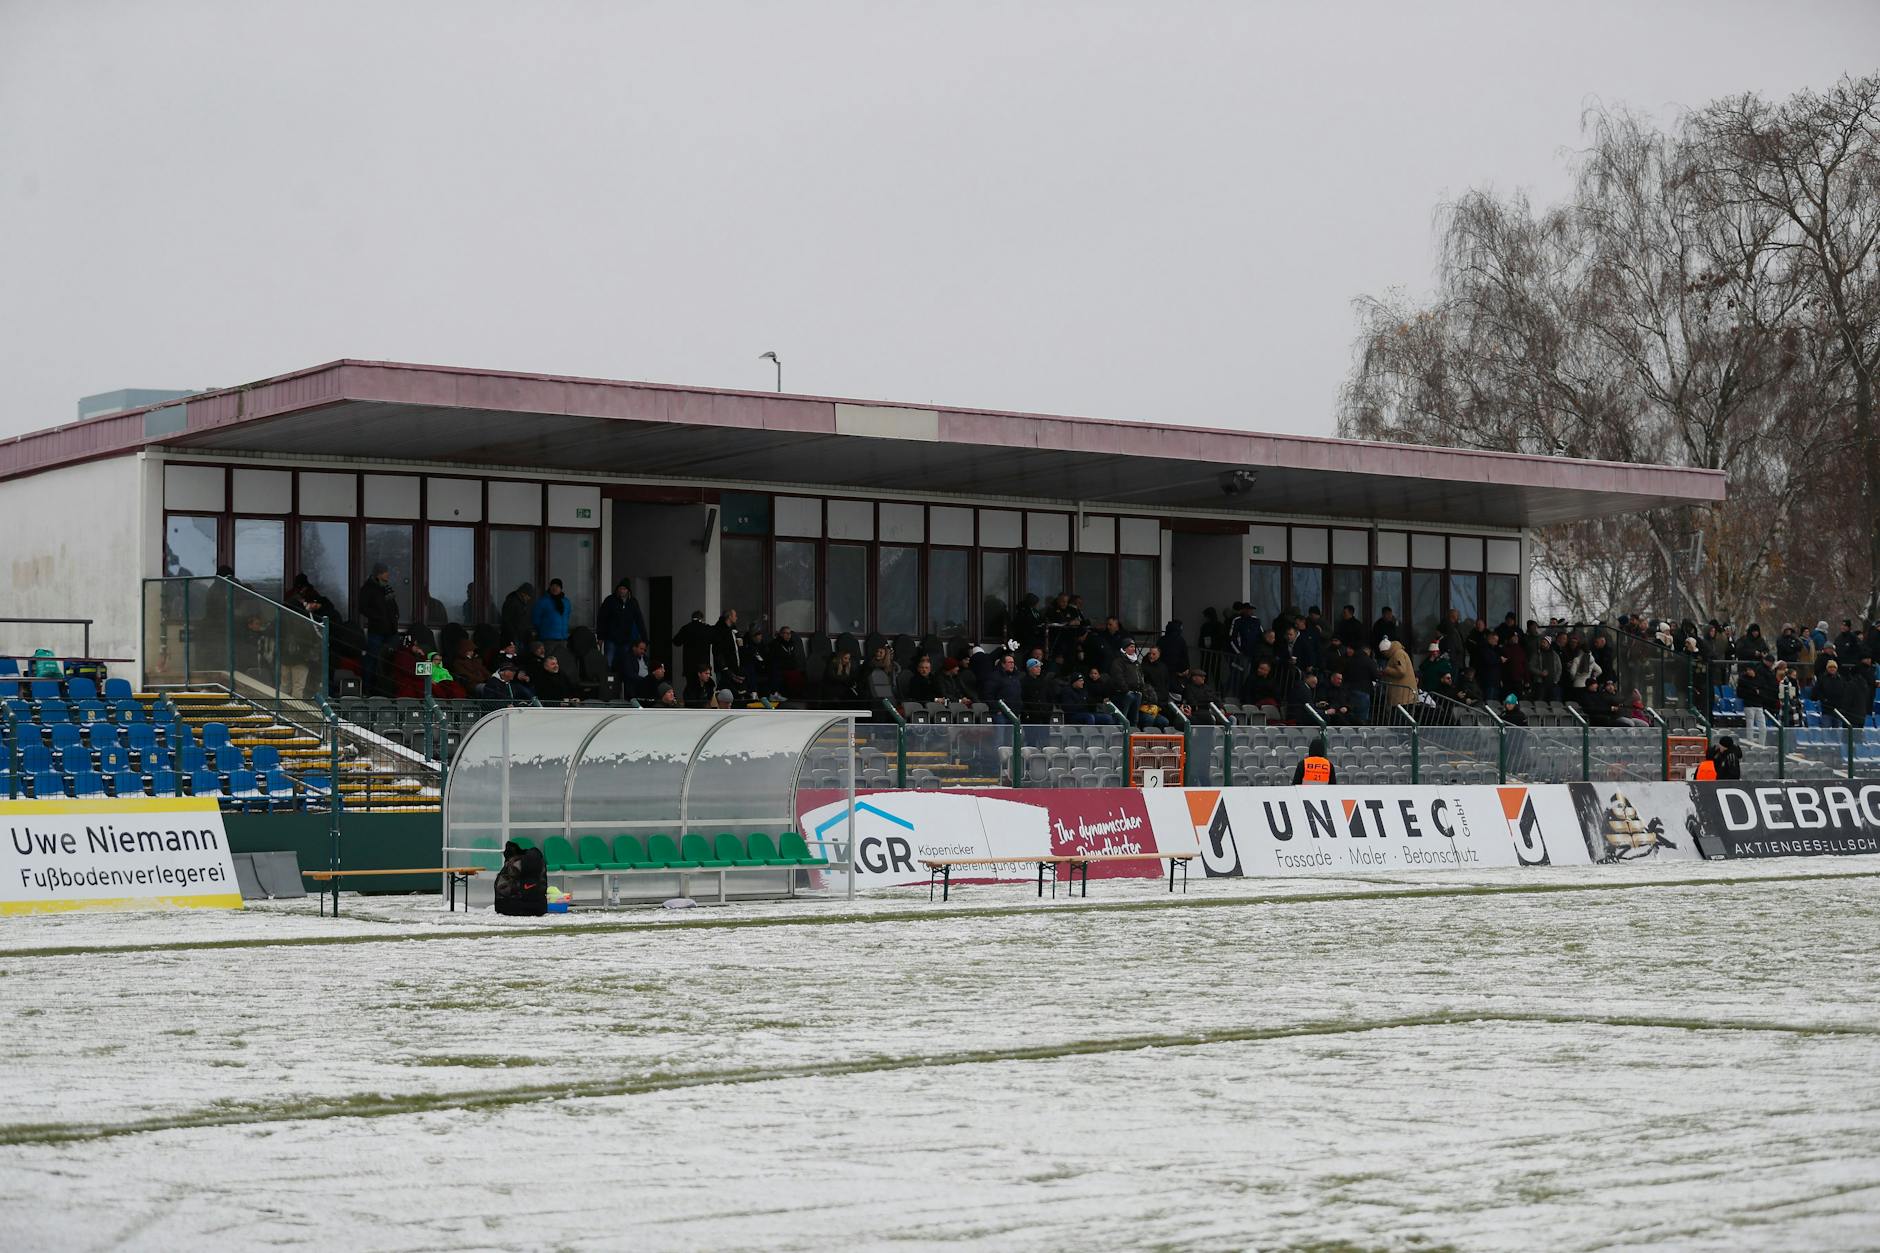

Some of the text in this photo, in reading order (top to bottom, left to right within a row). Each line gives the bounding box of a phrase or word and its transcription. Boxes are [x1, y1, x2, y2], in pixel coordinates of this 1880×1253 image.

[1307, 763, 1328, 771] BFC
[1053, 806, 1143, 846] Ihr dynamischer
[1263, 798, 1456, 842] UNITEC
[1454, 798, 1471, 838] GmbH
[11, 825, 218, 855] Uwe Niemann
[918, 844, 975, 858] Köpenicker
[1275, 845, 1480, 868] Fassade Maler Betonschutz
[21, 862, 226, 891] Fußbodenverlegerei
